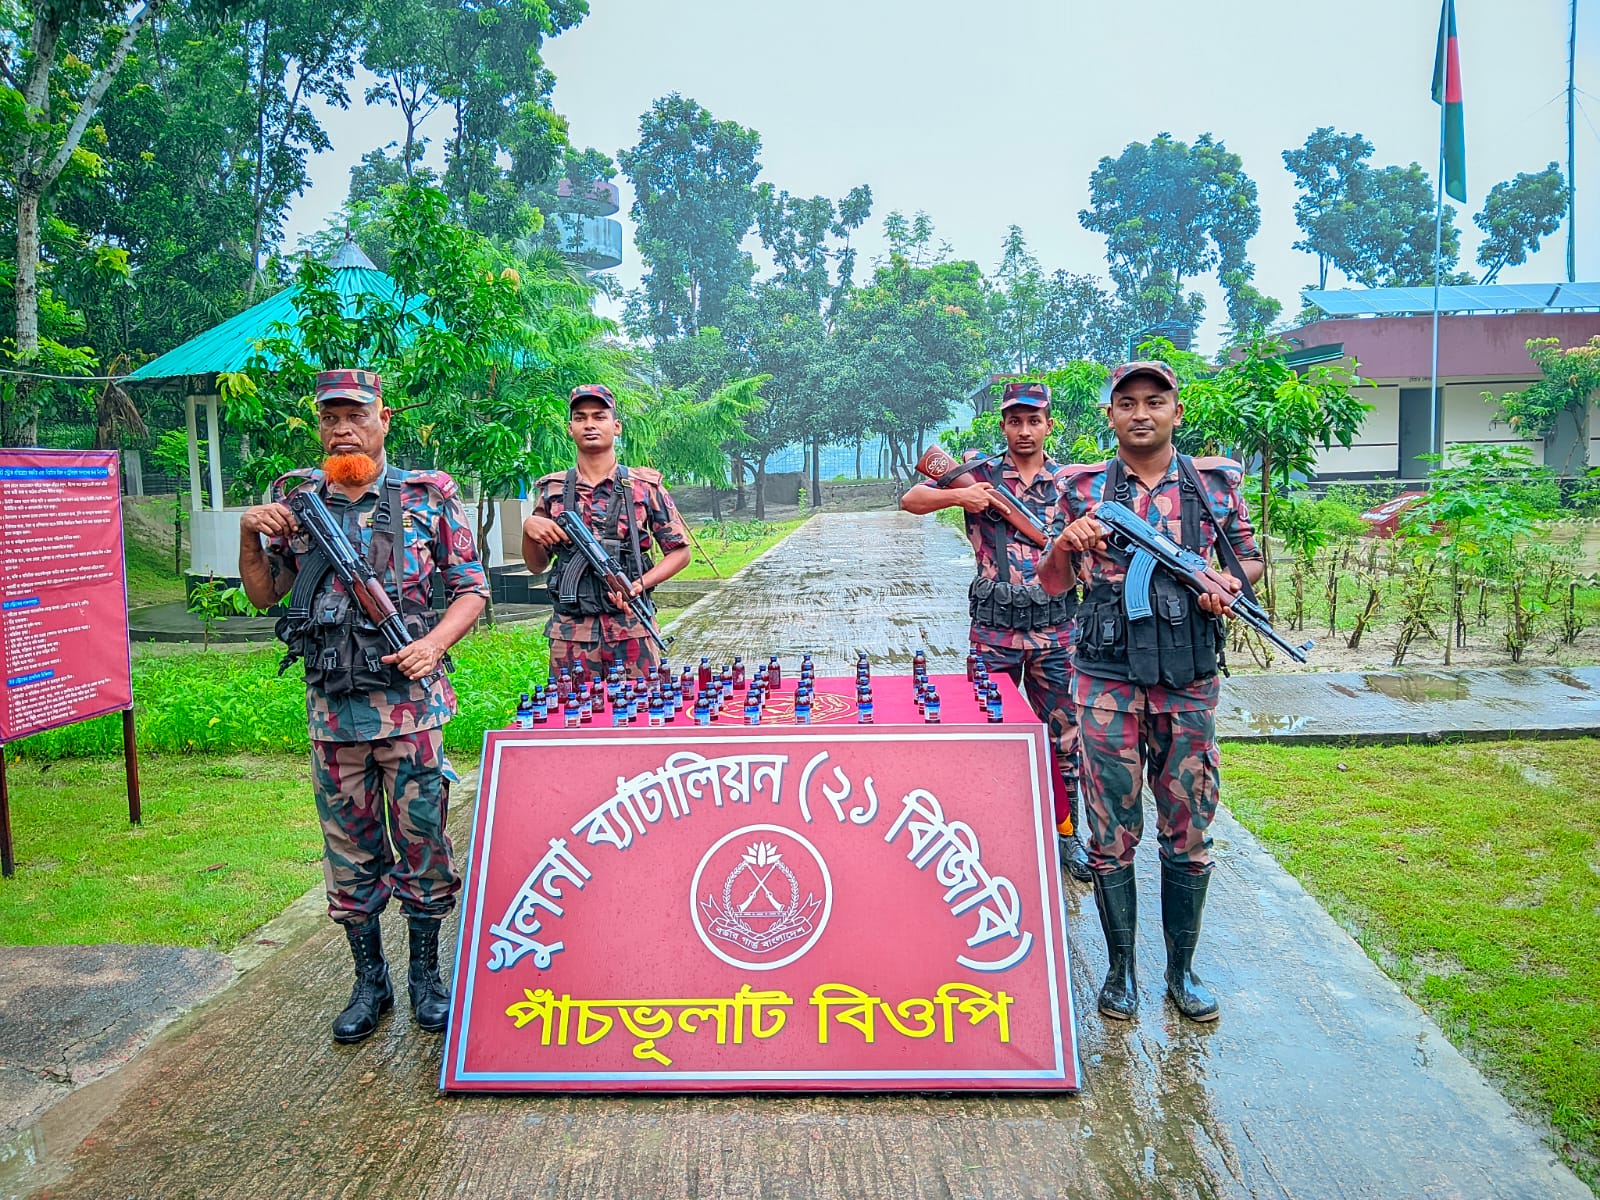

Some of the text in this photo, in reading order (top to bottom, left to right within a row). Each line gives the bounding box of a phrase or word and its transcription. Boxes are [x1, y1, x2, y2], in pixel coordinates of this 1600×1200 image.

[486, 751, 1034, 973] খুলনা ব্যাটালিয়ন (২১ বিজিবি)
[761, 926, 806, 949] বাংলাদেশ
[505, 982, 1014, 1067] পাঁচভূলাট বিওপি
